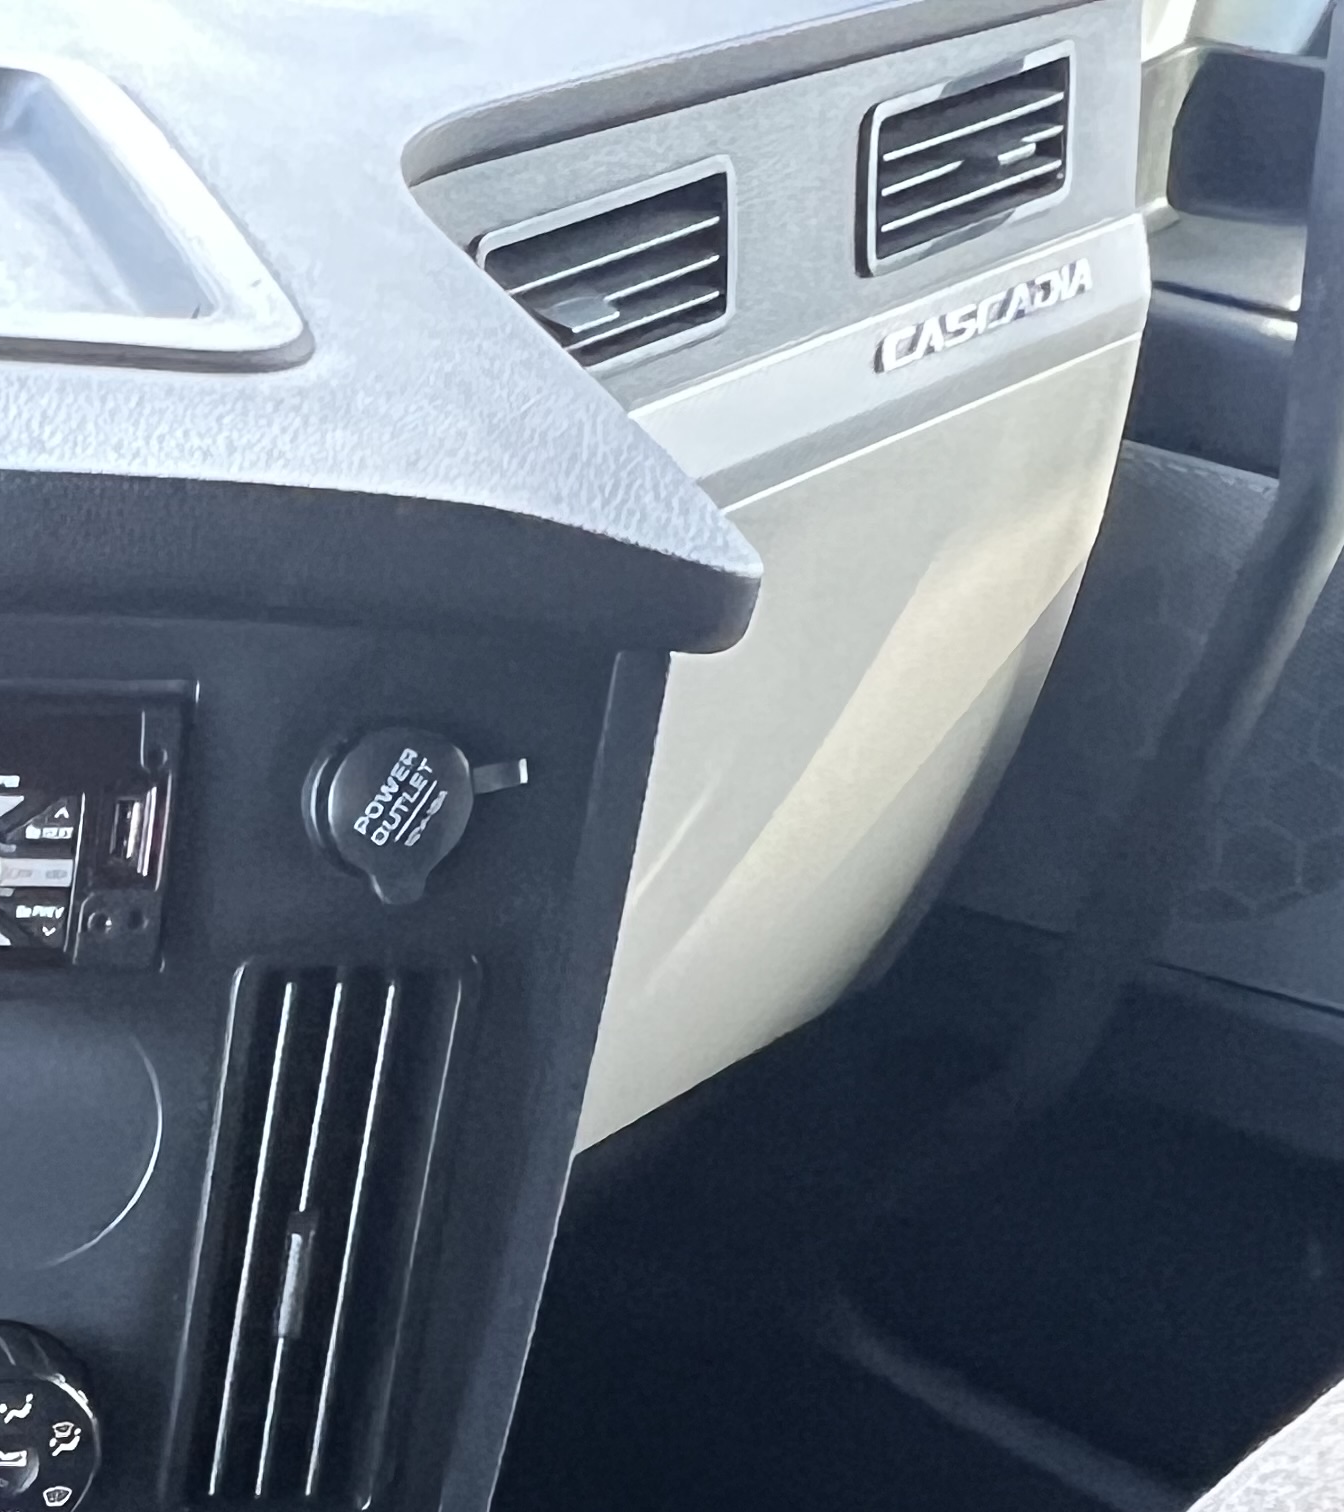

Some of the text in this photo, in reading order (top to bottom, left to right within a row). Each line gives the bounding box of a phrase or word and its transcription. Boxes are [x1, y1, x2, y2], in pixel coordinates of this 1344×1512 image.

[874, 257, 1093, 372] CASCADIA
[353, 748, 418, 836] POWER
[370, 757, 433, 847] OUTLET
